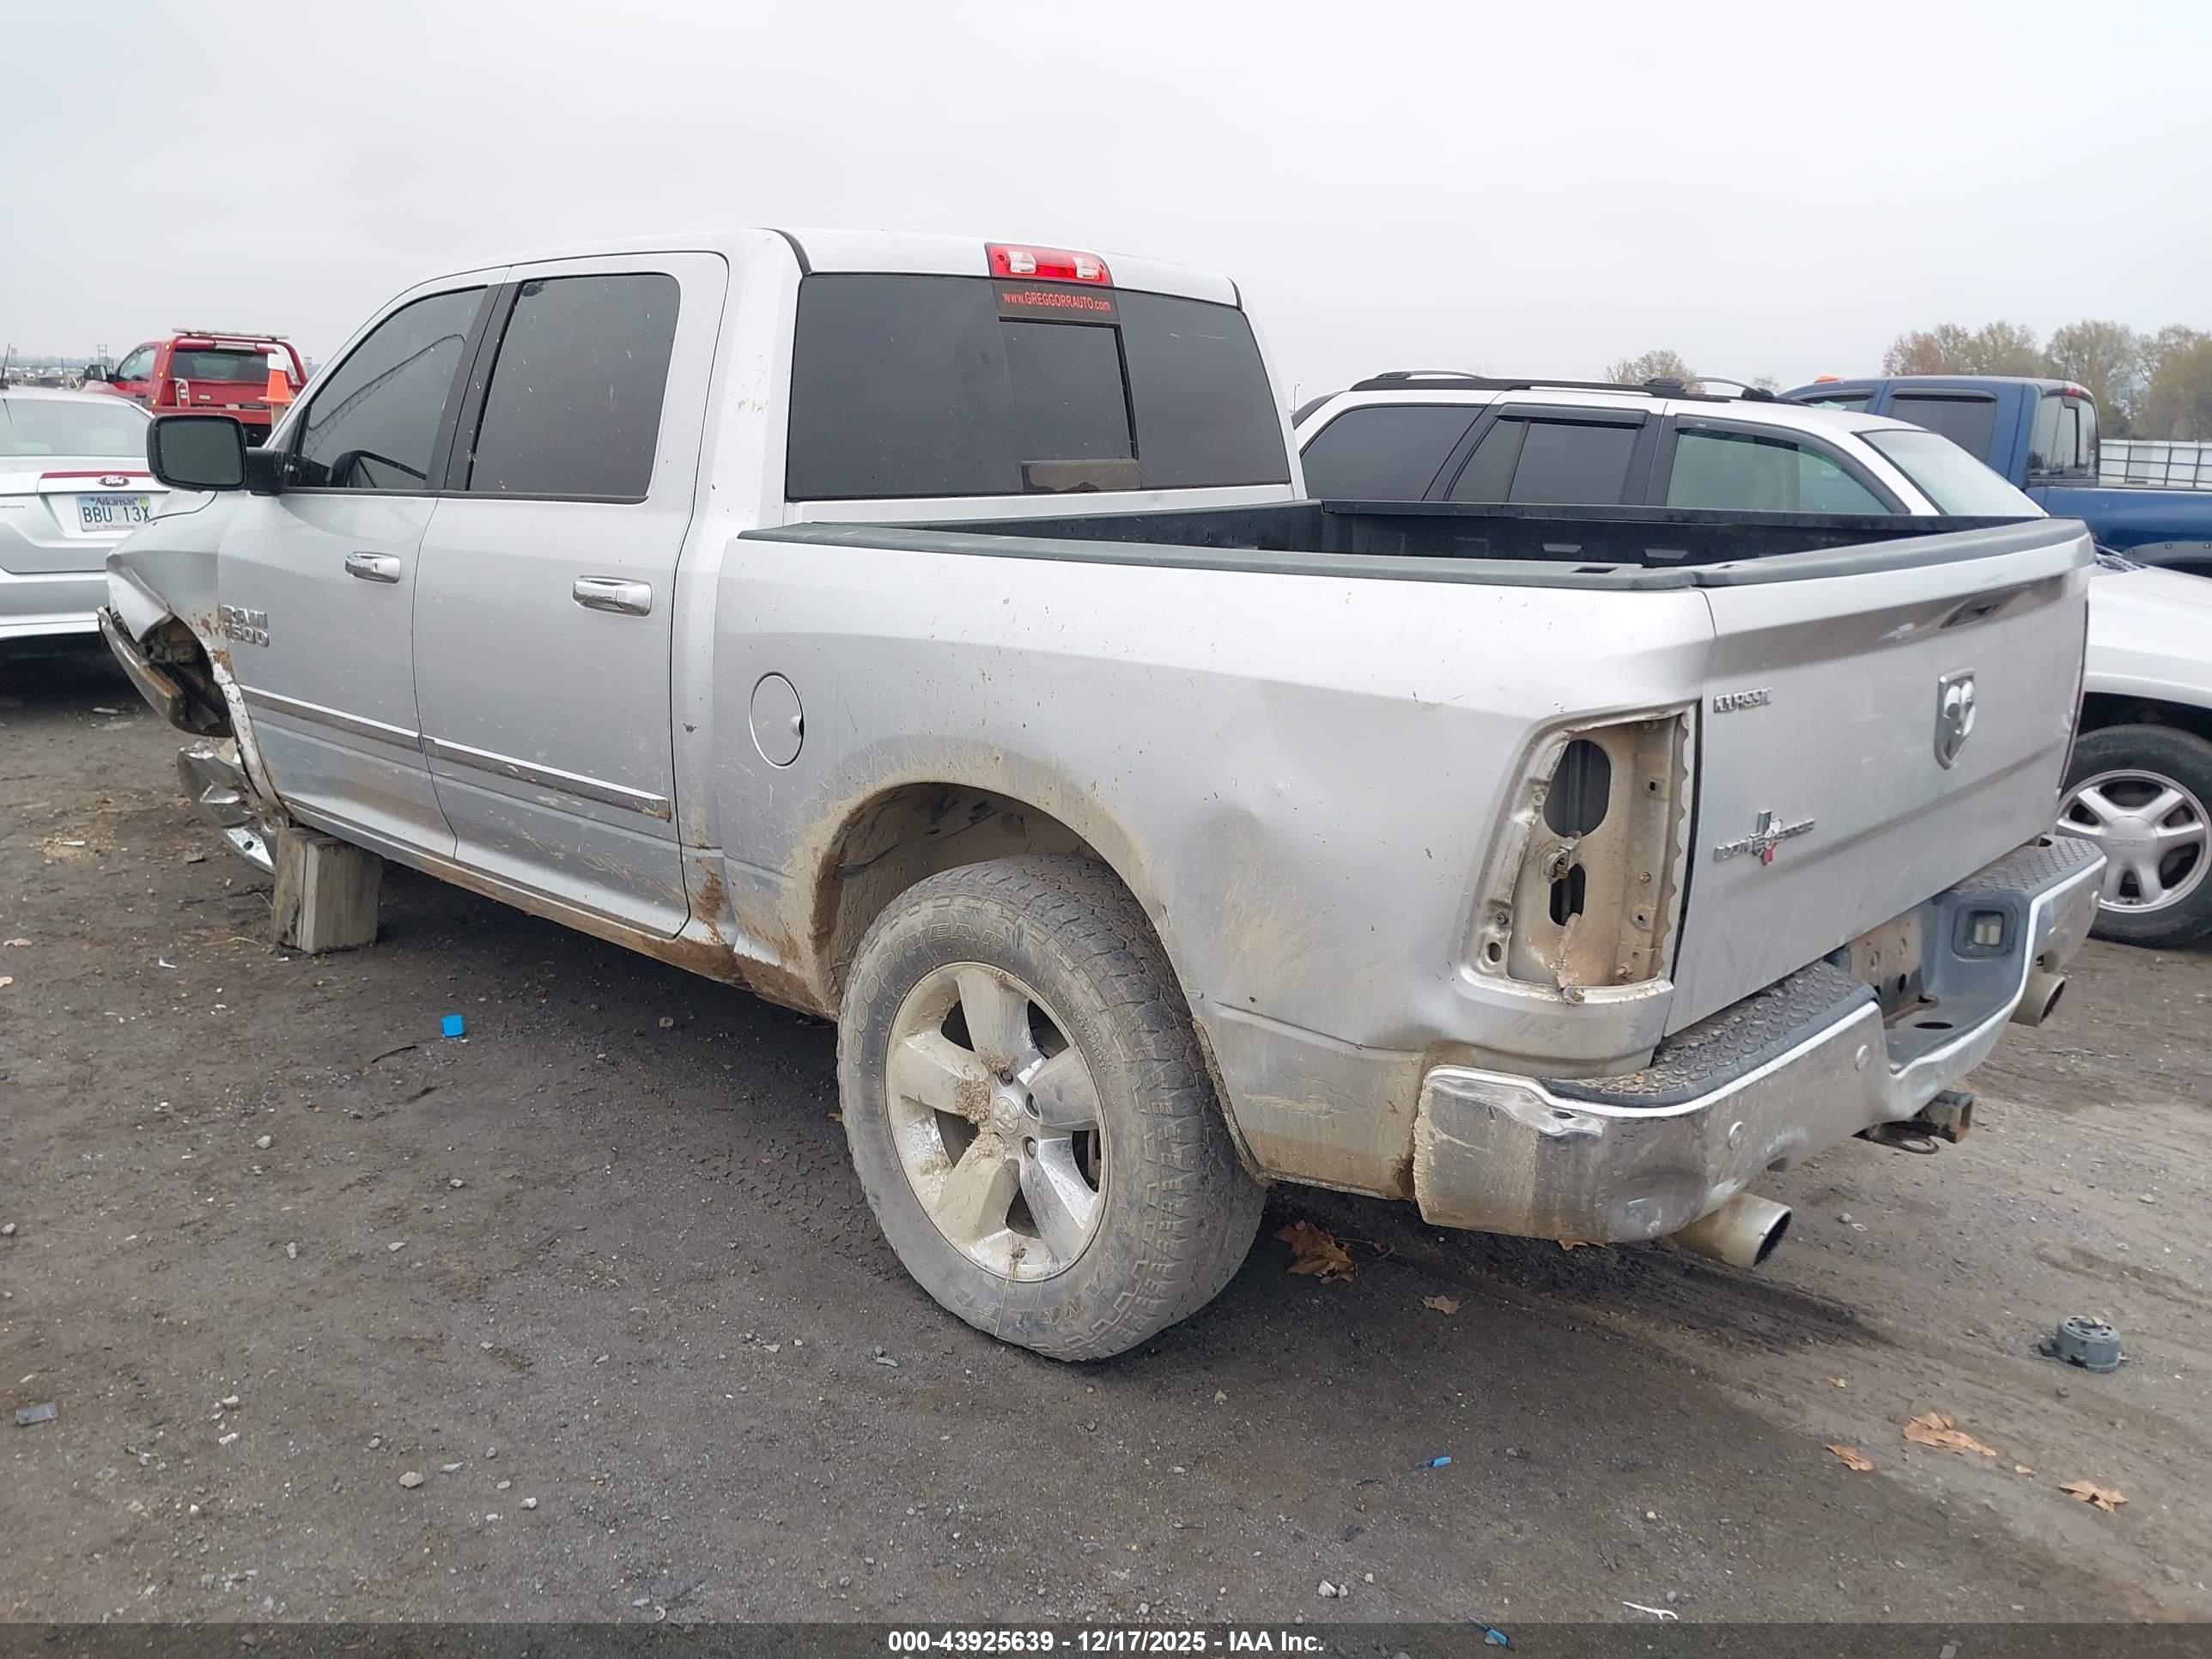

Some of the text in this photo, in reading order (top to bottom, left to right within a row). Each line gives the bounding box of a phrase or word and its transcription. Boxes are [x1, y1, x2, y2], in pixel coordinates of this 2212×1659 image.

[1002, 290, 1111, 312] www.GREGGORRAUTO.com
[94, 497, 137, 507] Arkansas
[82, 506, 150, 523] BBU 13X
[218, 604, 268, 629] RAM
[223, 622, 270, 647] 1500
[853, 922, 1006, 1066] GOODYEAR
